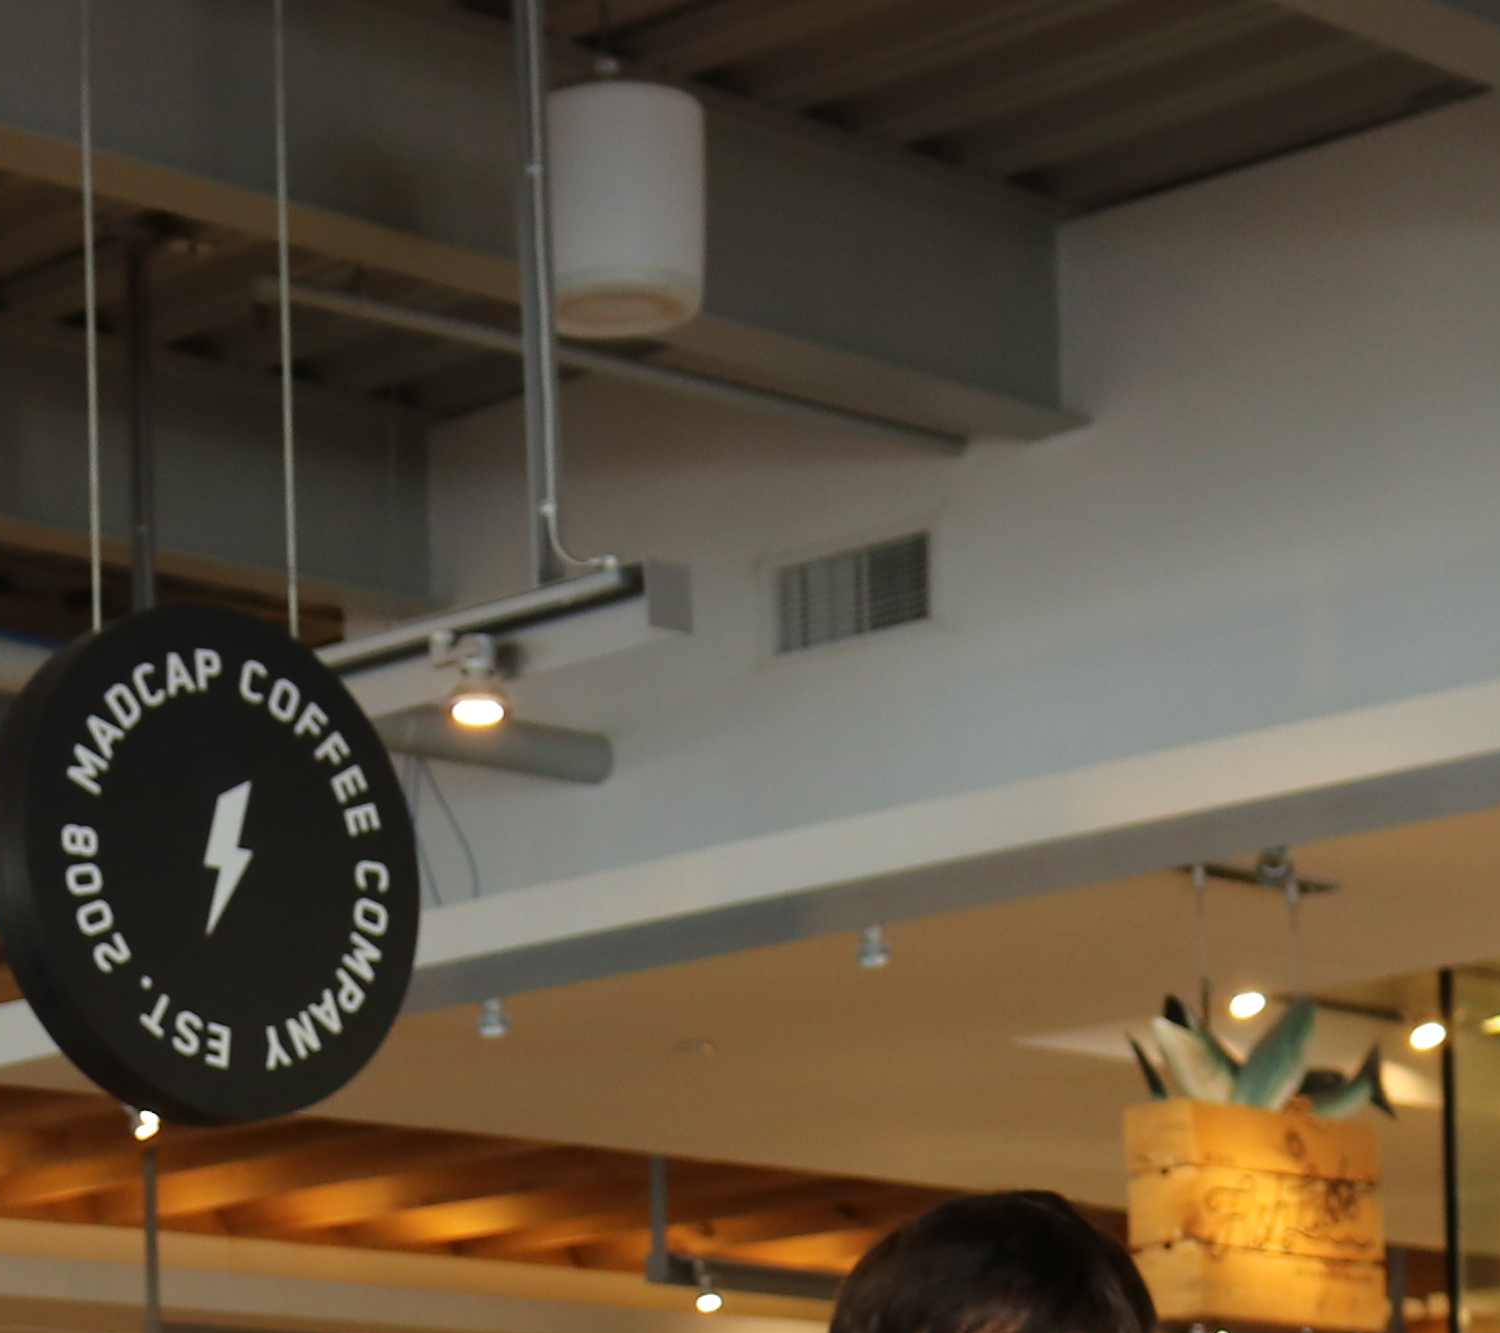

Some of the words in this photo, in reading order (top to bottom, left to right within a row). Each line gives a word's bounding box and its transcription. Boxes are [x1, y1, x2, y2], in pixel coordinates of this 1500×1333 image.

[66, 648, 222, 796] MADCAP
[239, 659, 382, 838] COFFEE
[59, 822, 132, 974] 2008
[265, 859, 390, 1071] COMPANY
